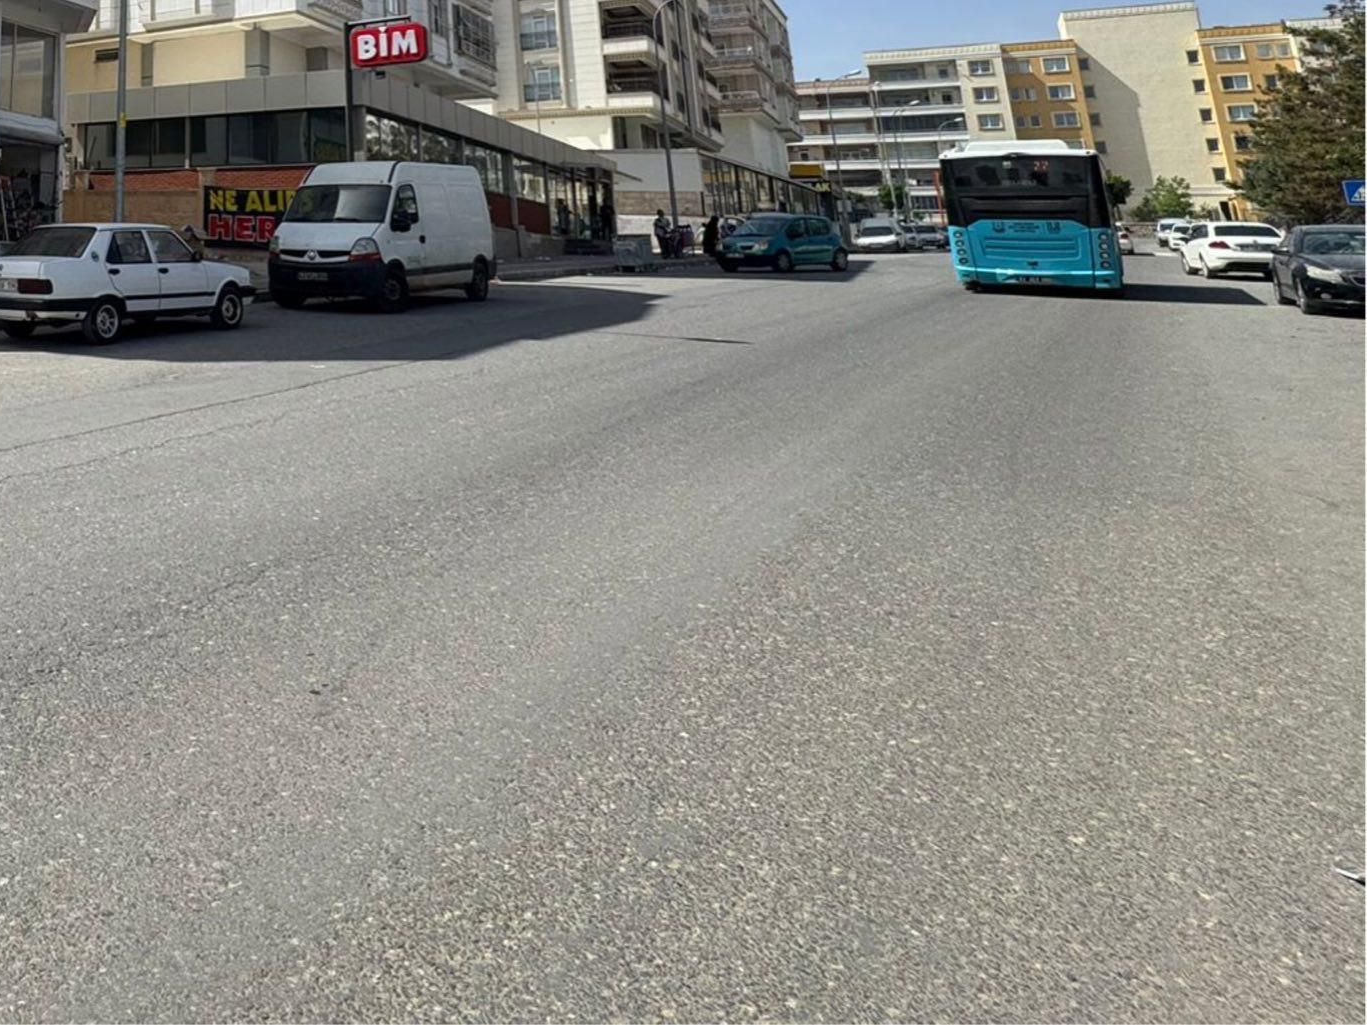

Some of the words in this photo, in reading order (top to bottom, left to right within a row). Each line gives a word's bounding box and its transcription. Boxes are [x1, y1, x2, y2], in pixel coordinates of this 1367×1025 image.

[357, 26, 419, 60] BİM
[209, 189, 238, 212] NE
[208, 213, 276, 243] HER
